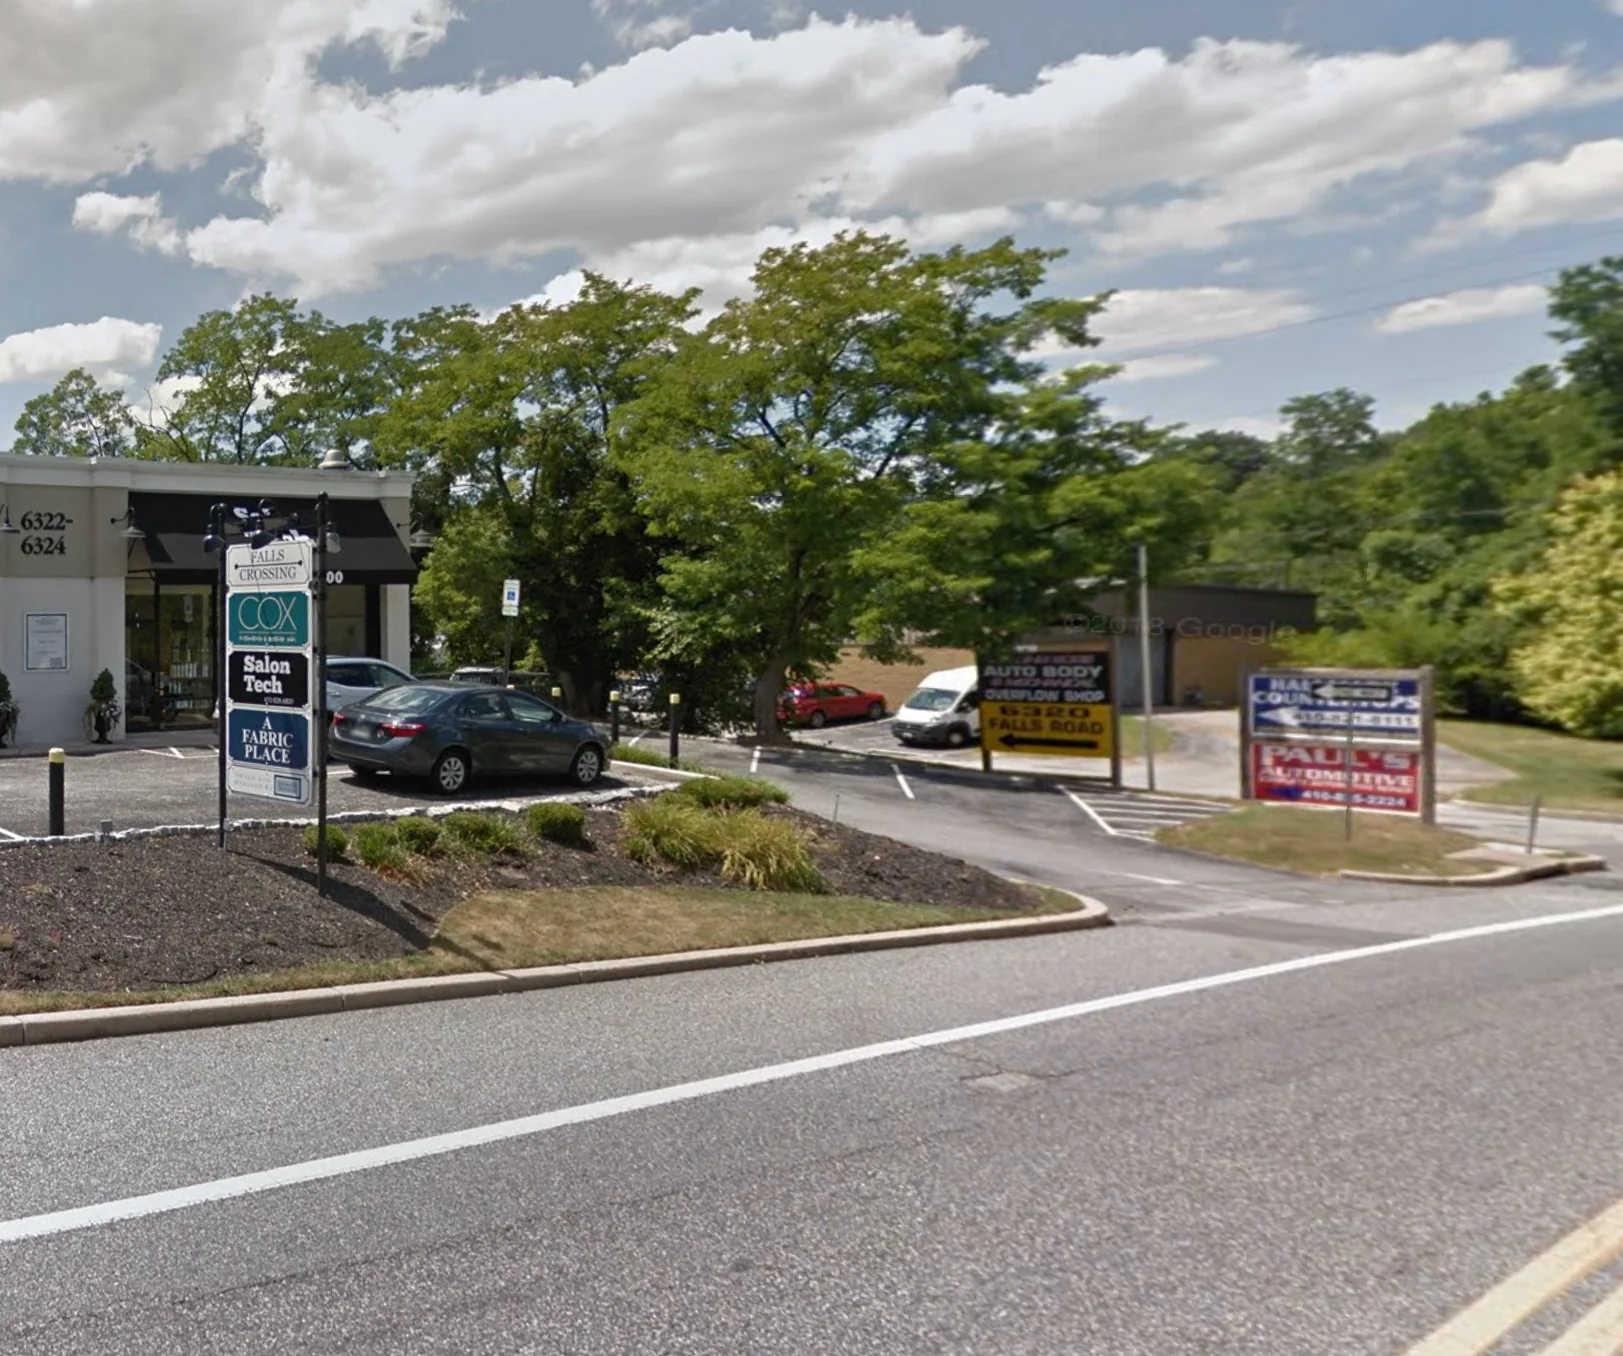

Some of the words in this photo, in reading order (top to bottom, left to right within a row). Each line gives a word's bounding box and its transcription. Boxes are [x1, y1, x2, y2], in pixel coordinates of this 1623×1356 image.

[21, 510, 73, 530] 6322-
[21, 535, 66, 555] 6324
[250, 549, 285, 564] FALLS
[239, 566, 297, 580] CROSSING
[238, 595, 297, 630] COX
[243, 654, 291, 674] Salon
[984, 665, 1036, 677] AUTO
[1042, 665, 1103, 678] BODY
[243, 675, 283, 694] Tech
[1063, 690, 1105, 702] SHOP
[1252, 691, 1420, 709] COUNPS
[999, 705, 1091, 718] 6320
[262, 716, 272, 730] A
[989, 717, 1043, 732] FALLS
[1050, 720, 1104, 735] ROAD
[242, 728, 294, 748] FABRIC
[244, 744, 291, 764] PLACE
[1261, 744, 1411, 769] PAUL'S
